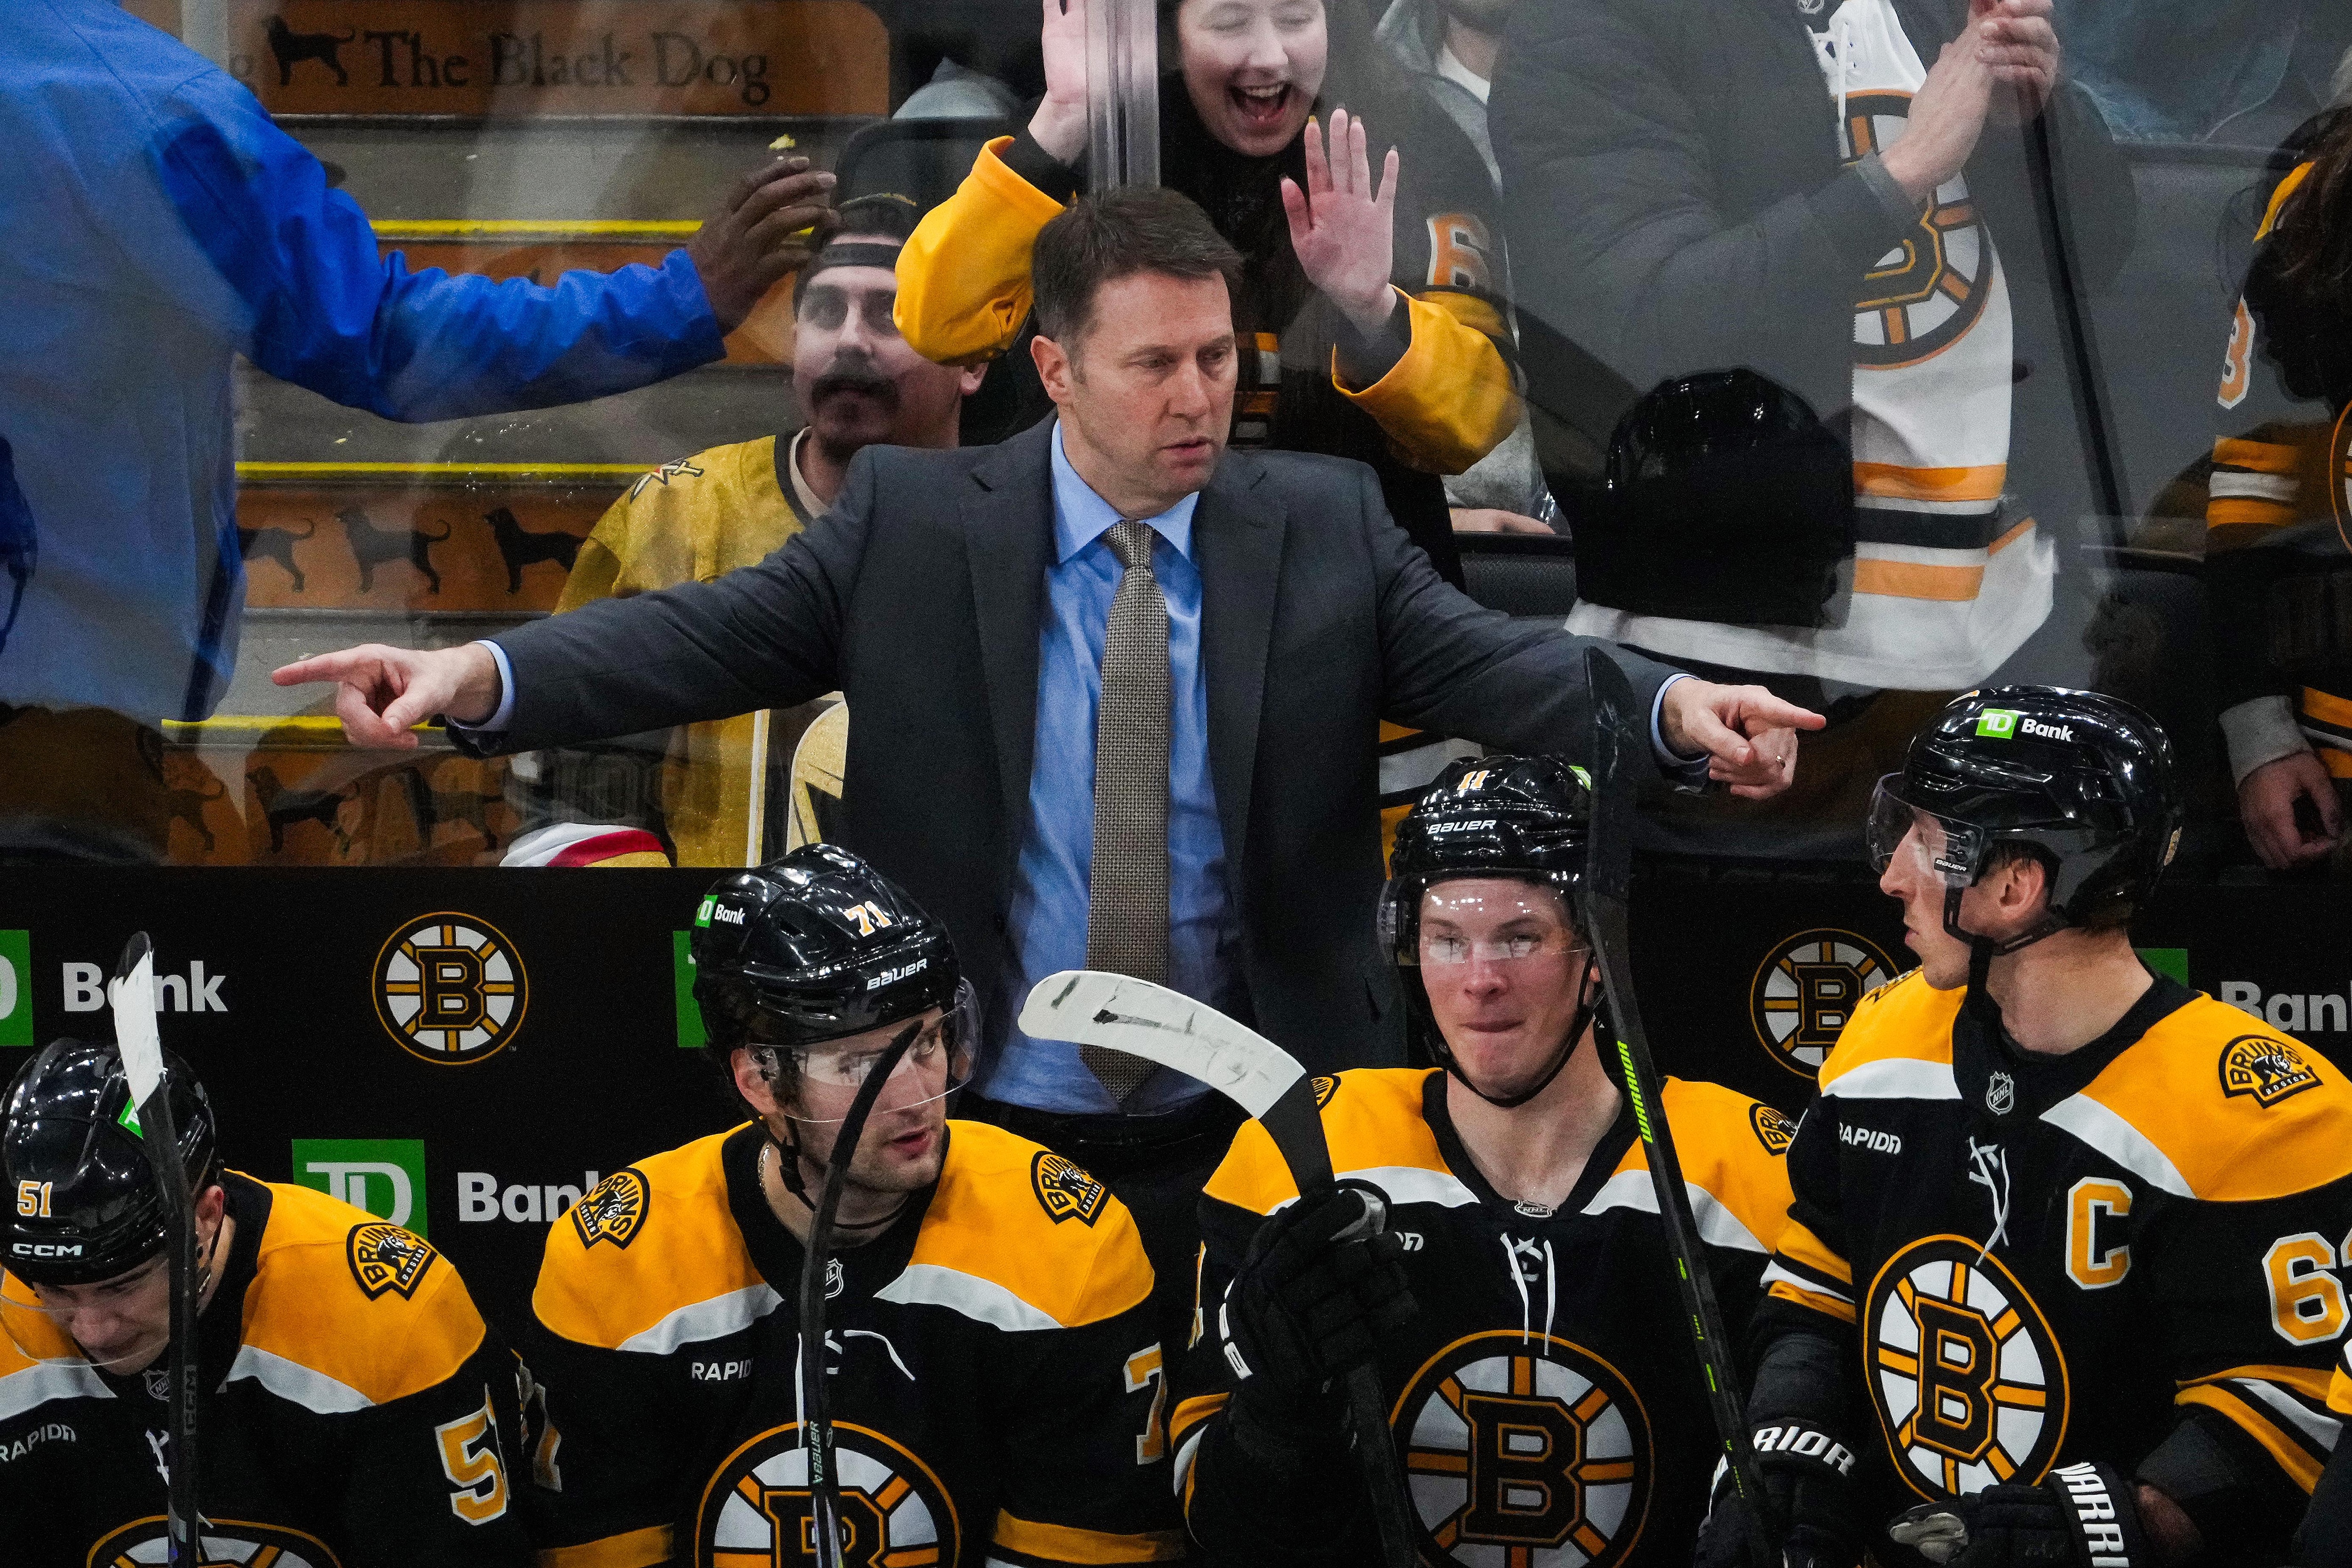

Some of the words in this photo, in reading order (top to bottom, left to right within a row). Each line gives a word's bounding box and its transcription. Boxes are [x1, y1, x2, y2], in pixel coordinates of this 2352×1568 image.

[365, 31, 469, 88] The
[488, 29, 636, 87] Black
[652, 31, 770, 106] Dog
[1985, 713, 2012, 731] TD
[2021, 718, 2074, 742] Bank
[1457, 771, 1489, 790] 11
[699, 900, 713, 921] D
[715, 904, 746, 925] Bank
[844, 900, 892, 937] 71
[63, 960, 229, 1012] Bnk
[2221, 980, 2352, 1032] Ban
[2230, 1041, 2304, 1084] BRUINS
[1617, 1040, 1653, 1144] WARRIOR
[17, 1180, 53, 1218] 51
[306, 1162, 413, 1227] TD
[595, 1175, 640, 1236] BRUINS
[12, 1242, 83, 1257] CCM
[358, 1226, 412, 1285] BRUINS
[2066, 1176, 2133, 1290] C
[2262, 1231, 2352, 1347] 6
[1913, 1297, 1998, 1460] B
[434, 1393, 510, 1526] 5
